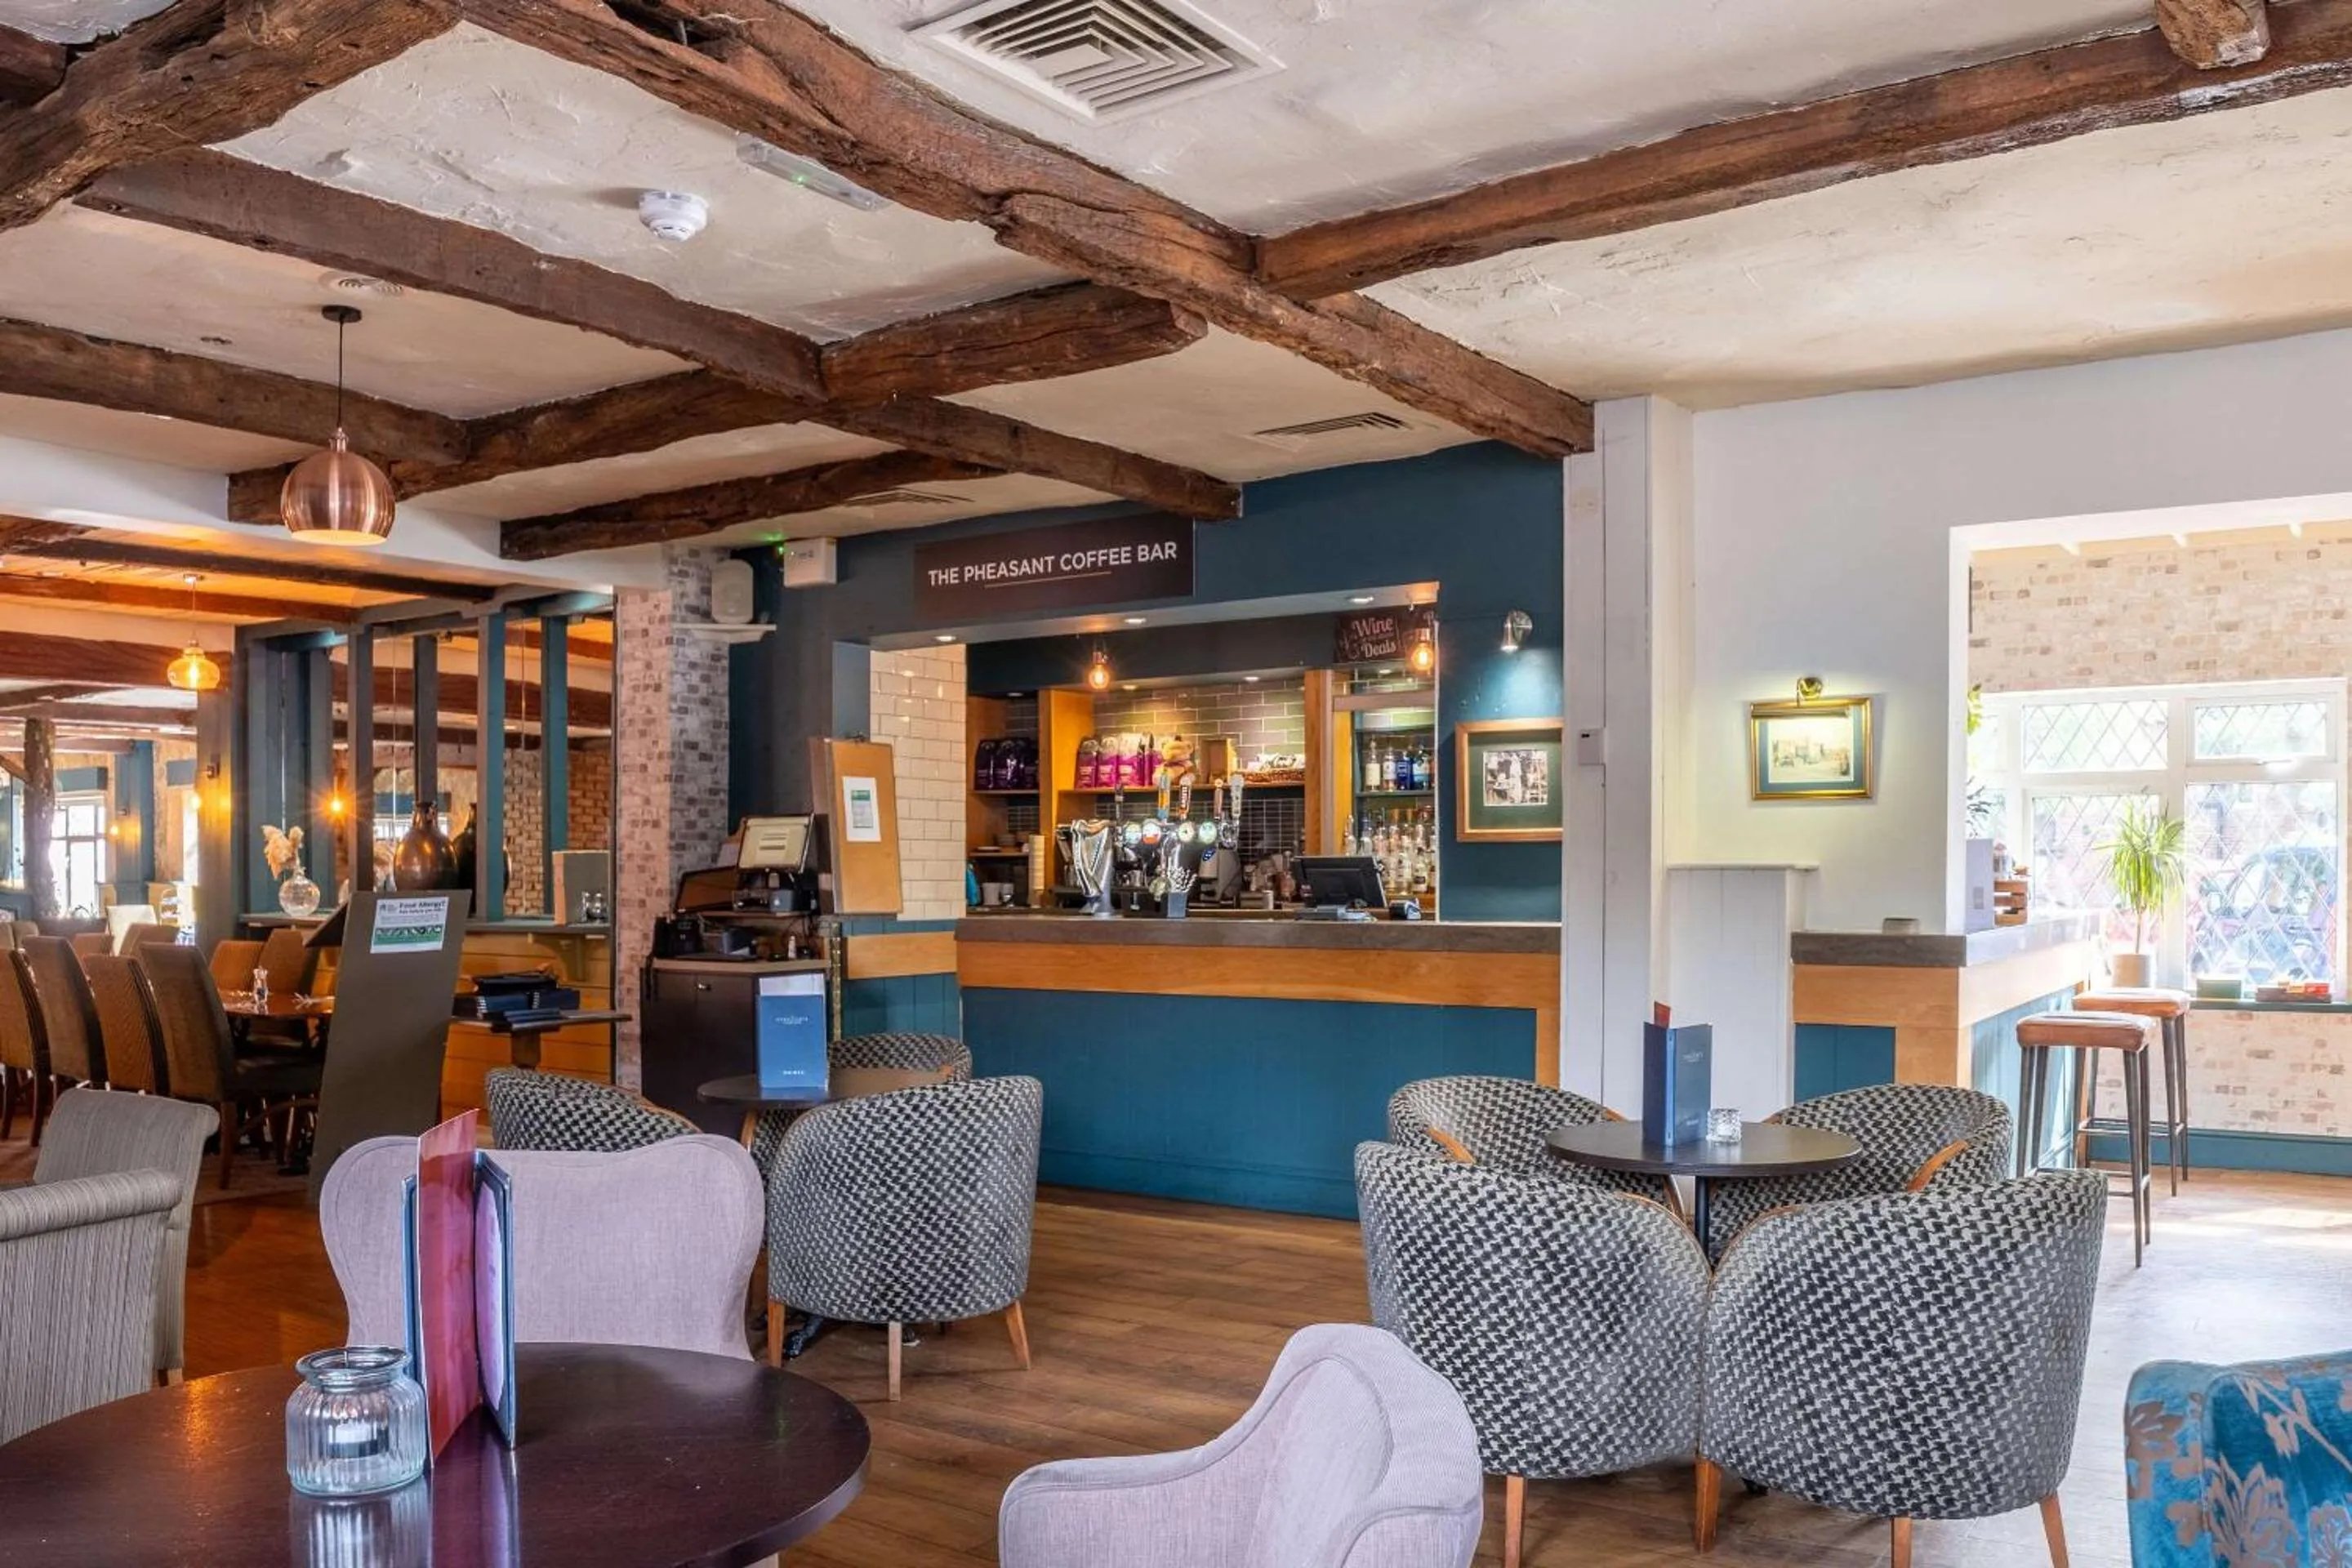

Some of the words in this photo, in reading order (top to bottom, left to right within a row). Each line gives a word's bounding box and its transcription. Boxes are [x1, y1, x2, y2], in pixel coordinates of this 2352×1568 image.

[928, 567, 960, 586] THE
[964, 555, 1055, 582] PHEASANT
[1059, 546, 1132, 571] COFFEE
[1137, 541, 1177, 563] BAR
[1352, 617, 1393, 637] Wine
[1361, 639, 1396, 658] Deals
